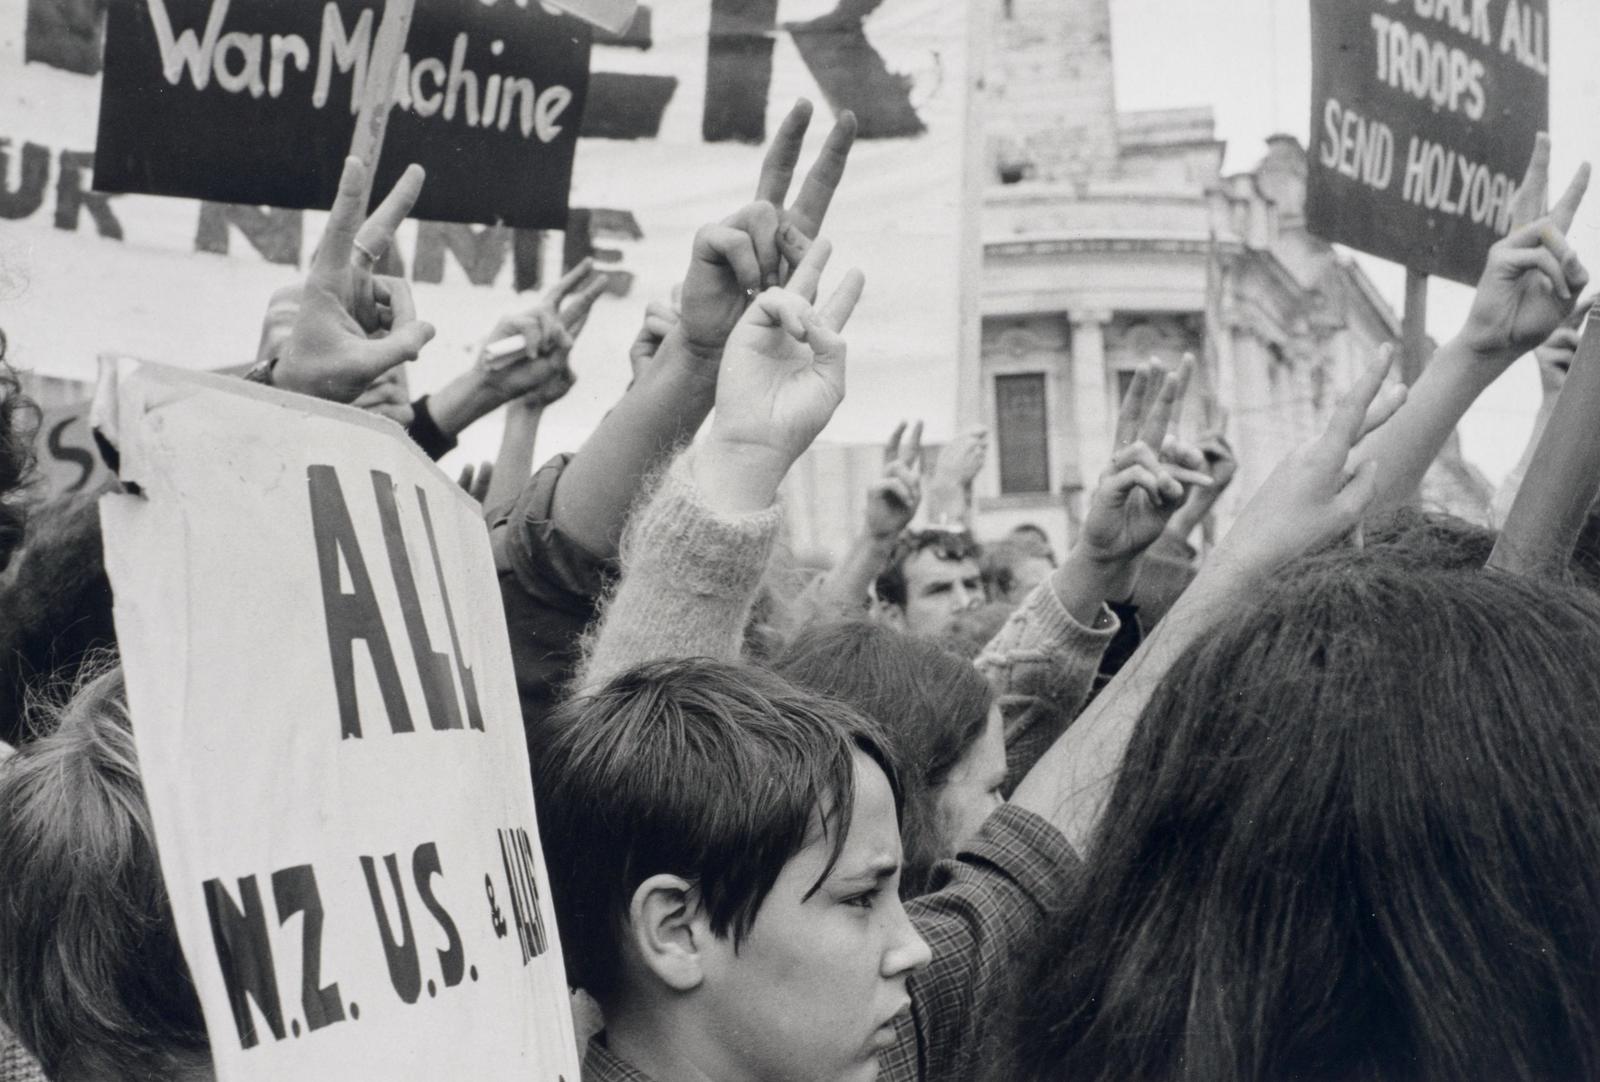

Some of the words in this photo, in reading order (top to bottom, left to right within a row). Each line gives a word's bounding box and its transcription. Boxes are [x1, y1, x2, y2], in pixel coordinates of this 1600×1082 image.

[147, 0, 310, 98] War
[1371, 13, 1486, 120] TROOPS
[1500, 0, 1549, 76] ALL
[1320, 98, 1394, 190] SEND
[307, 463, 486, 741] ALL
[203, 863, 361, 1051] N.Z.
[358, 841, 478, 1005] U.S.
